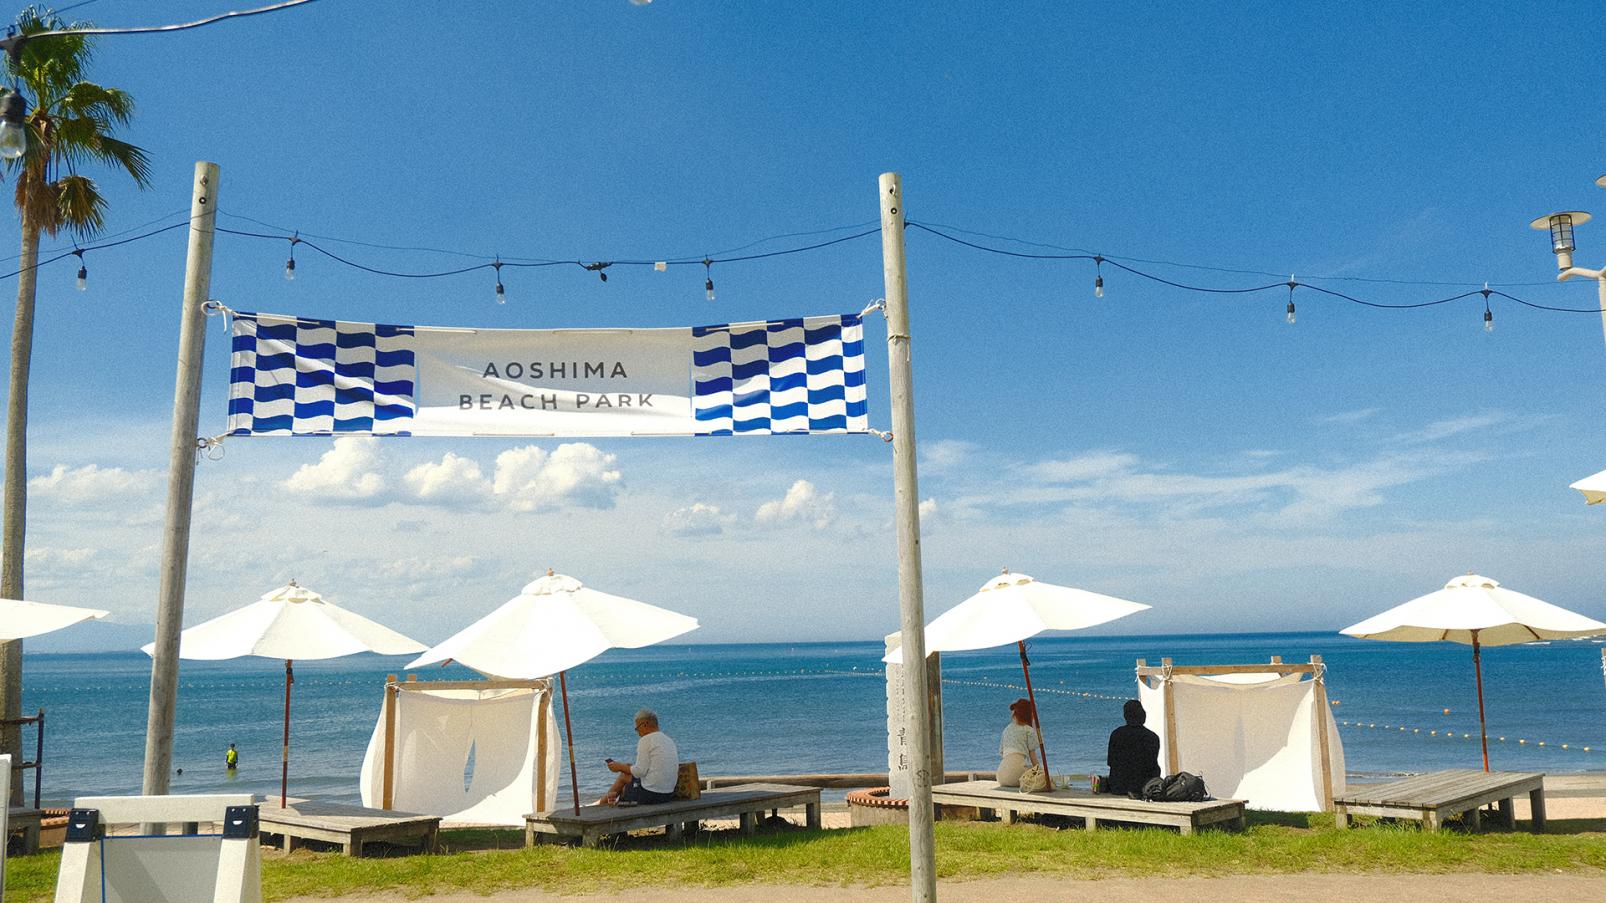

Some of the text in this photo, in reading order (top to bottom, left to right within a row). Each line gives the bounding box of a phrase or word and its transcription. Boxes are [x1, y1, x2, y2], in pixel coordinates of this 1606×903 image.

[483, 362, 628, 379] AOSHIMA
[459, 393, 654, 410] BEACH PARK
